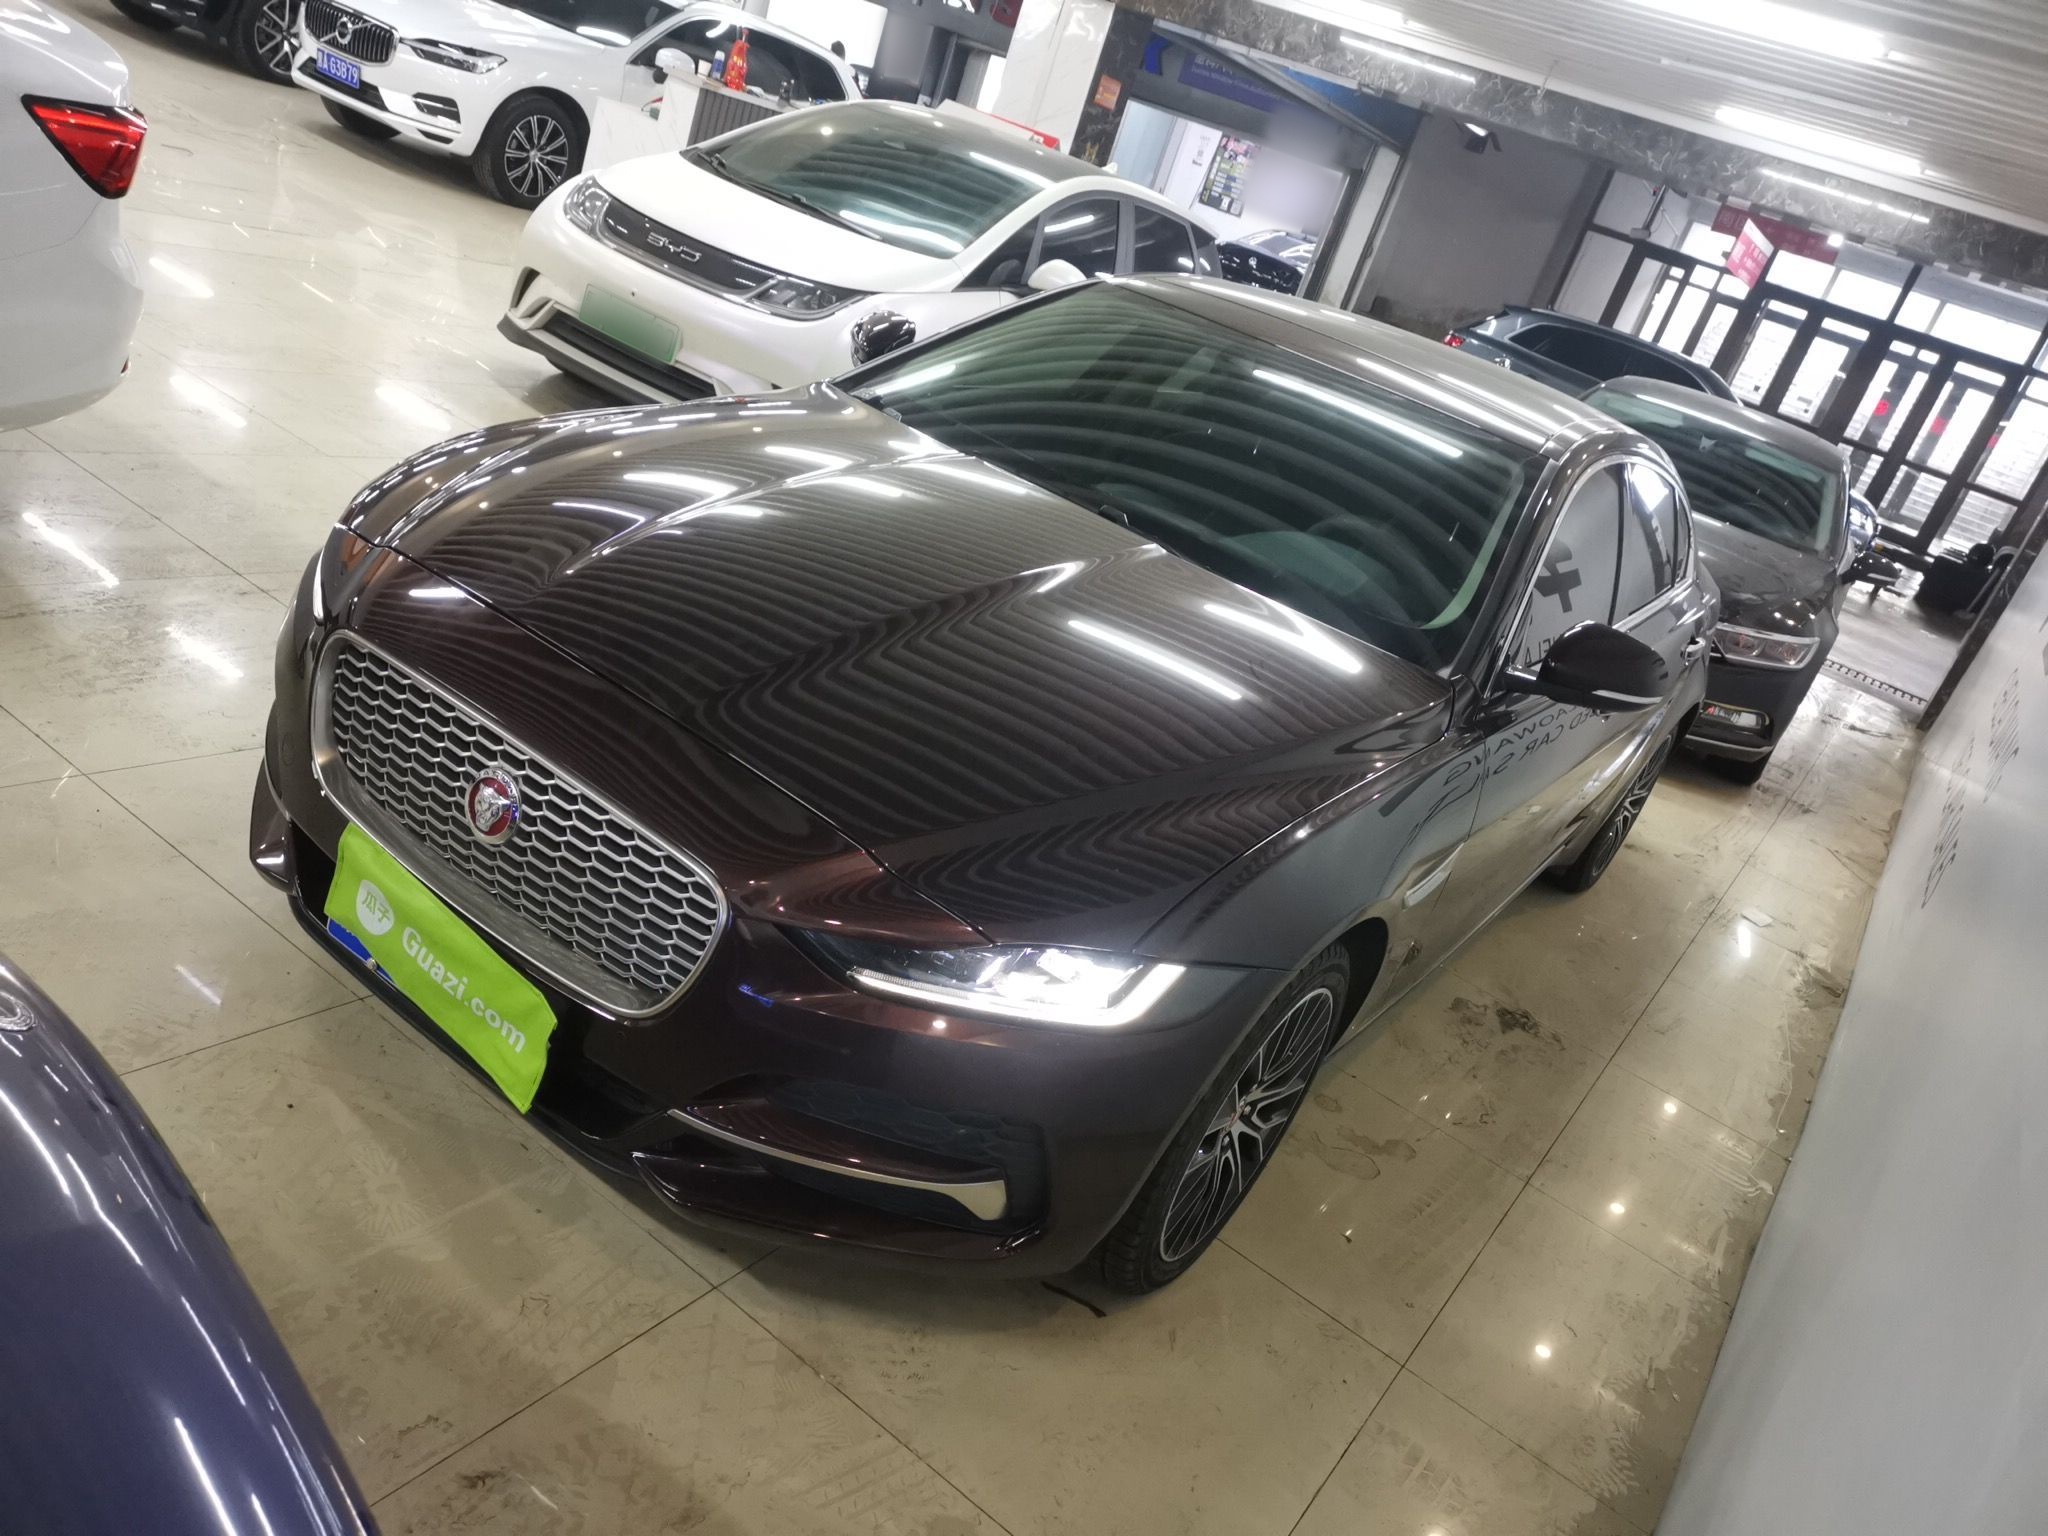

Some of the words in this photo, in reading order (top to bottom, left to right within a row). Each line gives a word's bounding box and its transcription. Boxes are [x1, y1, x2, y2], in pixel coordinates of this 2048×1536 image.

[647, 232, 702, 262] BYD
[361, 891, 391, 922] 瓜子
[402, 926, 526, 1054] Guazi.com
